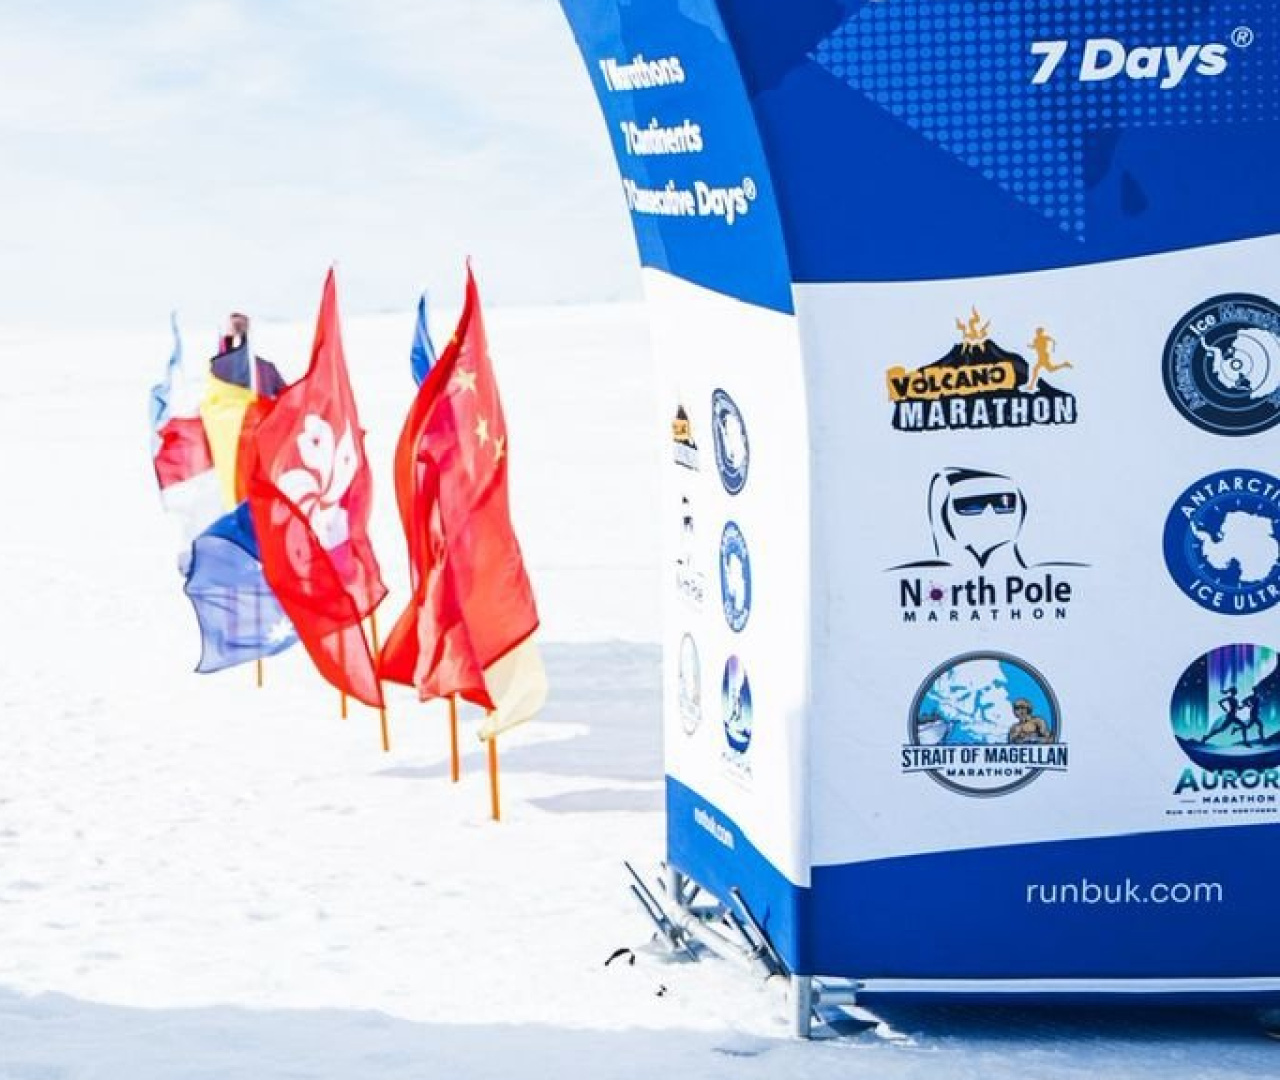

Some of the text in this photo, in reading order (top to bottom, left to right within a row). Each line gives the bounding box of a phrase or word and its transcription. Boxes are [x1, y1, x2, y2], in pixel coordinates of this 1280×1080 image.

[1029, 40, 1068, 85] 7
[1190, 314, 1217, 335] Ice
[891, 367, 1007, 397] VOLCANO
[899, 395, 1073, 428] MARATHON
[1180, 476, 1280, 519] ANTARCTI
[1005, 574, 1072, 604] Pole
[1190, 579, 1280, 610] ICE ULTR
[903, 607, 1067, 622] MARATHON
[901, 747, 1069, 768] STRAIT OF MAGELLAN
[946, 768, 1022, 777] MARATHON
[1172, 766, 1280, 795] AUROR
[1202, 794, 1276, 804] MARATHON
[1026, 878, 1223, 904] runbuk.com
